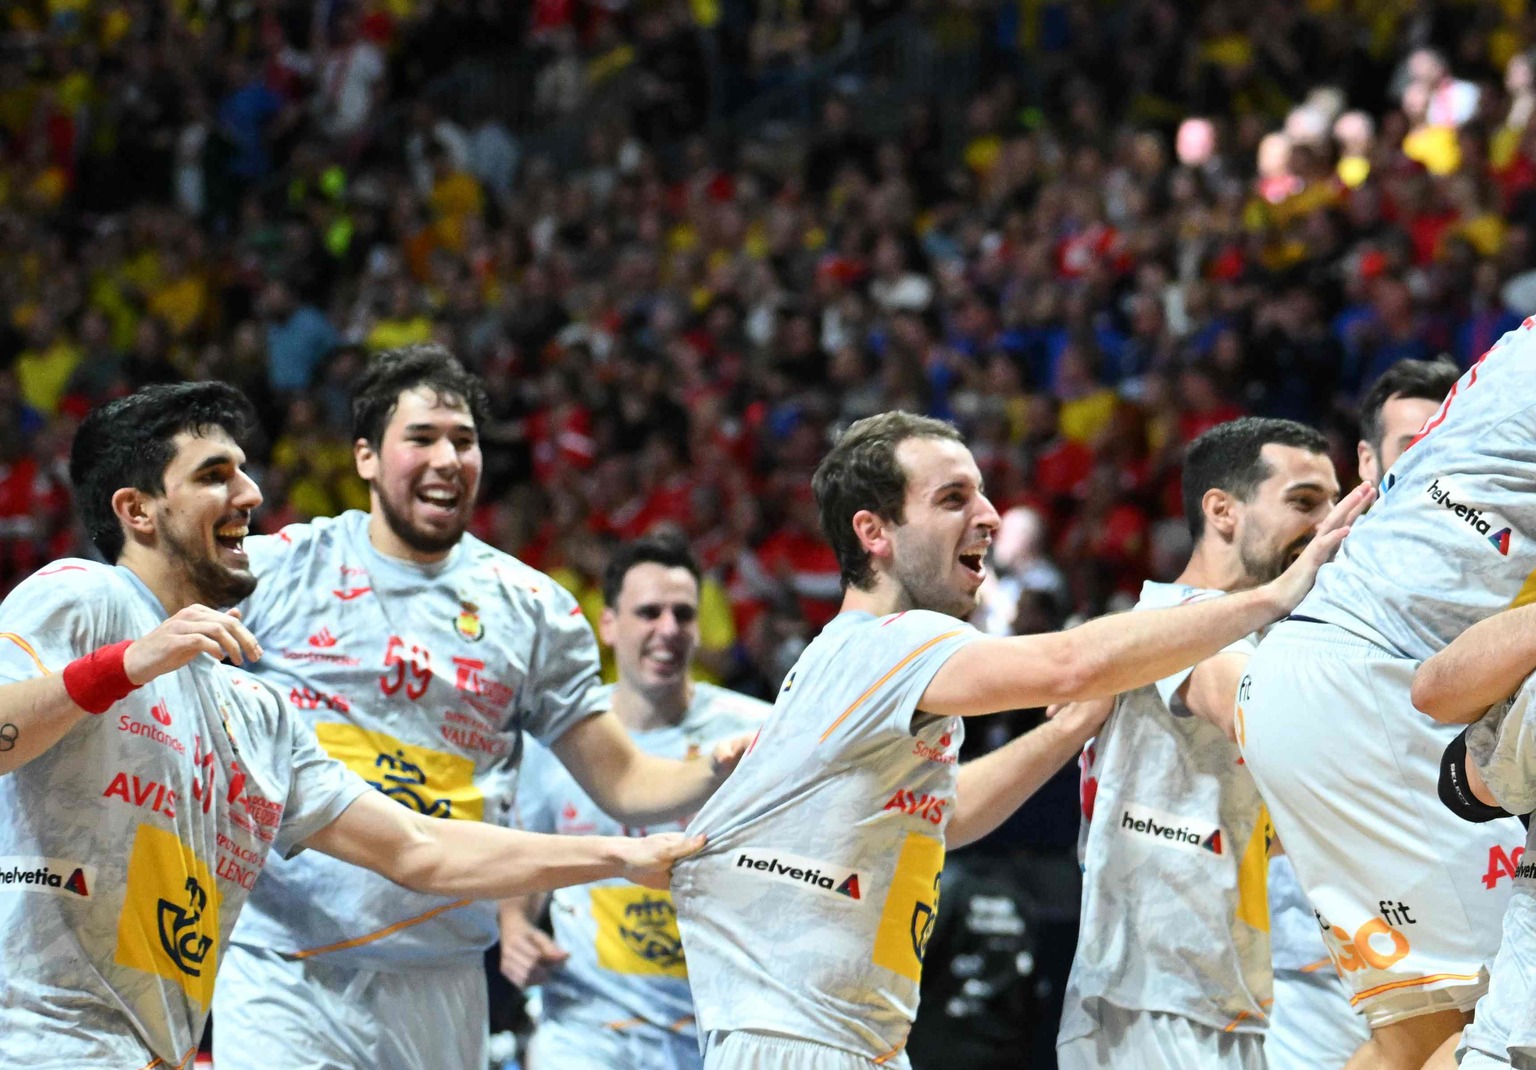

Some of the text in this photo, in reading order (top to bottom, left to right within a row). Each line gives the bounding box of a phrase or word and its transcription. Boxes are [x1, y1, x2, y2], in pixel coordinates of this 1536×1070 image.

[1426, 480, 1491, 536] helvetia
[103, 772, 176, 818] AVIS
[883, 788, 946, 824] AVIS
[1121, 811, 1201, 845] helvetia
[736, 854, 835, 890] helvetia
[1379, 900, 1417, 926] fit
